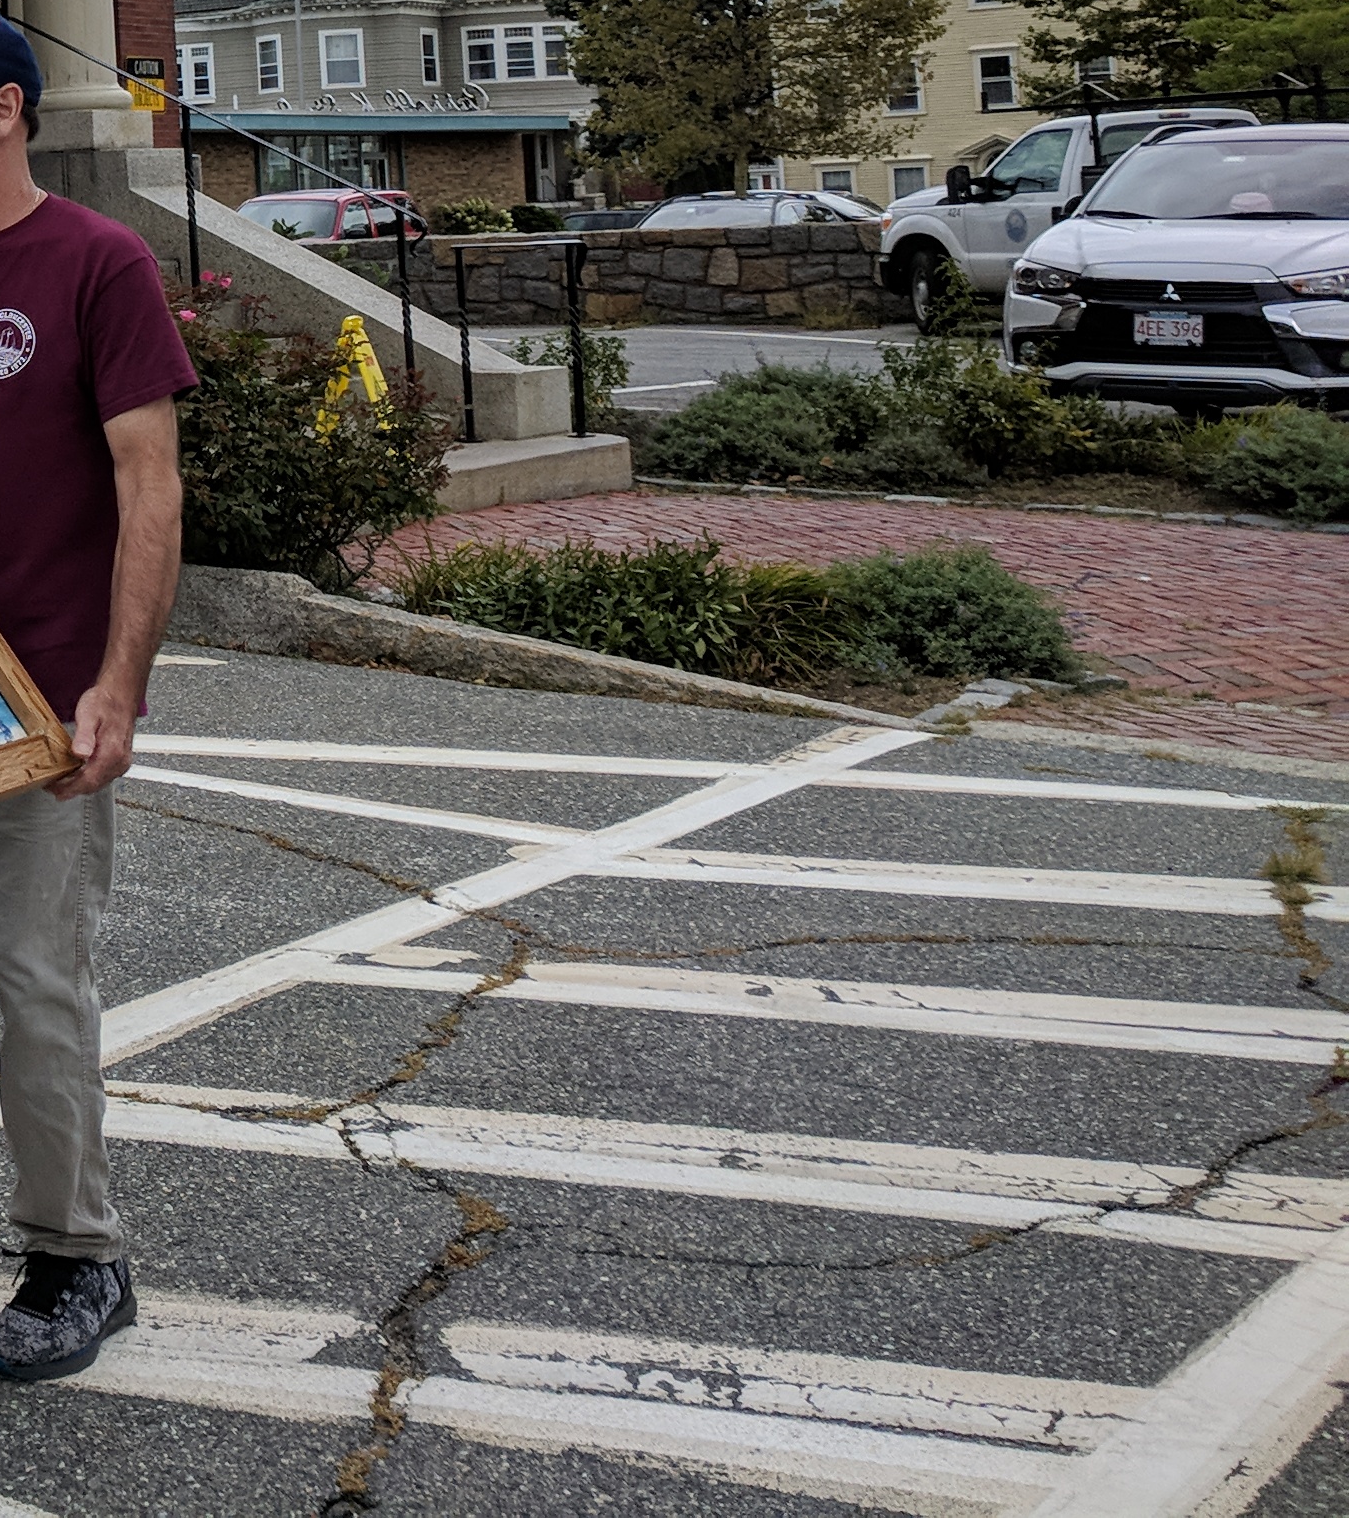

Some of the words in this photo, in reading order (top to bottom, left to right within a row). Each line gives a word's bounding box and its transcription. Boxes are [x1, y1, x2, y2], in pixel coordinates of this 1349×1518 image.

[134, 60, 159, 75] CAUTION
[1136, 320, 1166, 337] 4EE
[1170, 321, 1201, 338] 396
